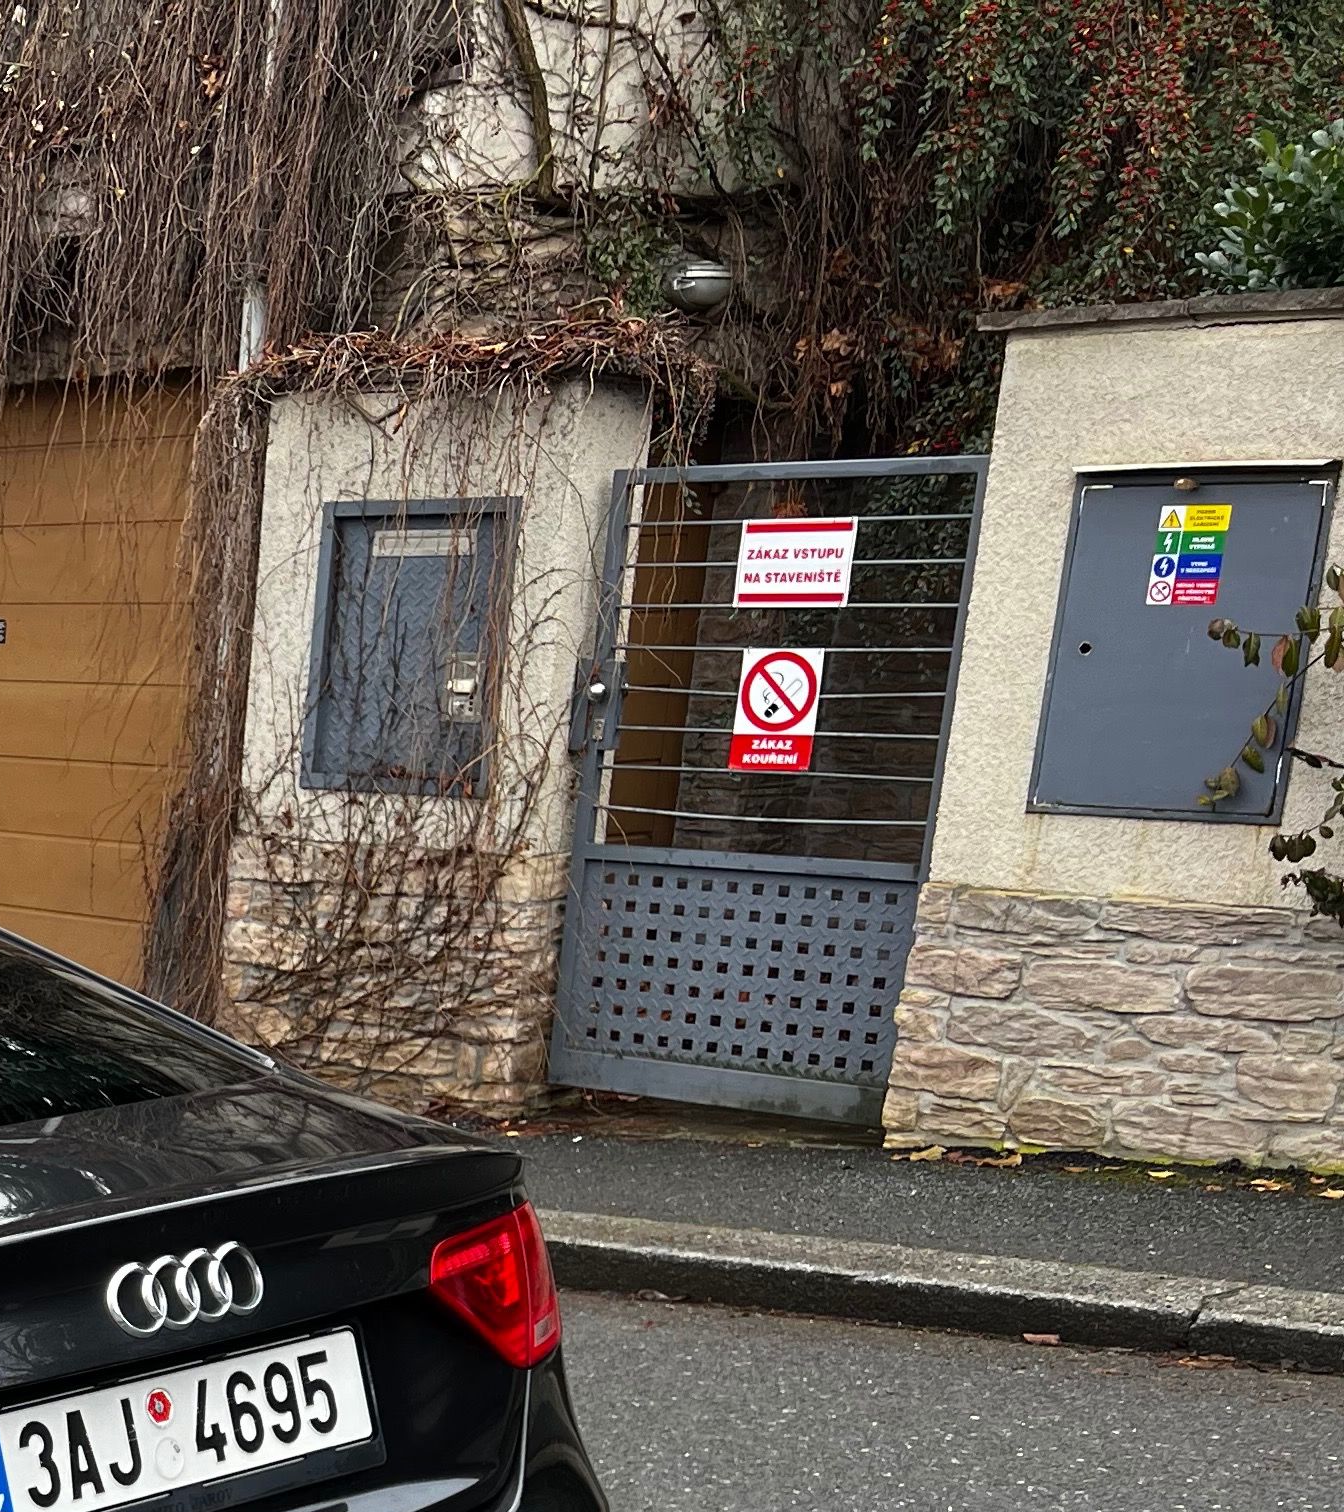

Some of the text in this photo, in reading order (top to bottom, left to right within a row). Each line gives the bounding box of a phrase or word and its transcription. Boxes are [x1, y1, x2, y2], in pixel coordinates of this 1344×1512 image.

[747, 546, 844, 560] ZÁKAZ VSTUPU
[744, 569, 841, 583] NA STAVENIŠTĚ
[751, 738, 793, 750] ZÁKAZ
[742, 752, 798, 764] KOUŘENÍ
[18, 1350, 339, 1508] 3AJ 4695
